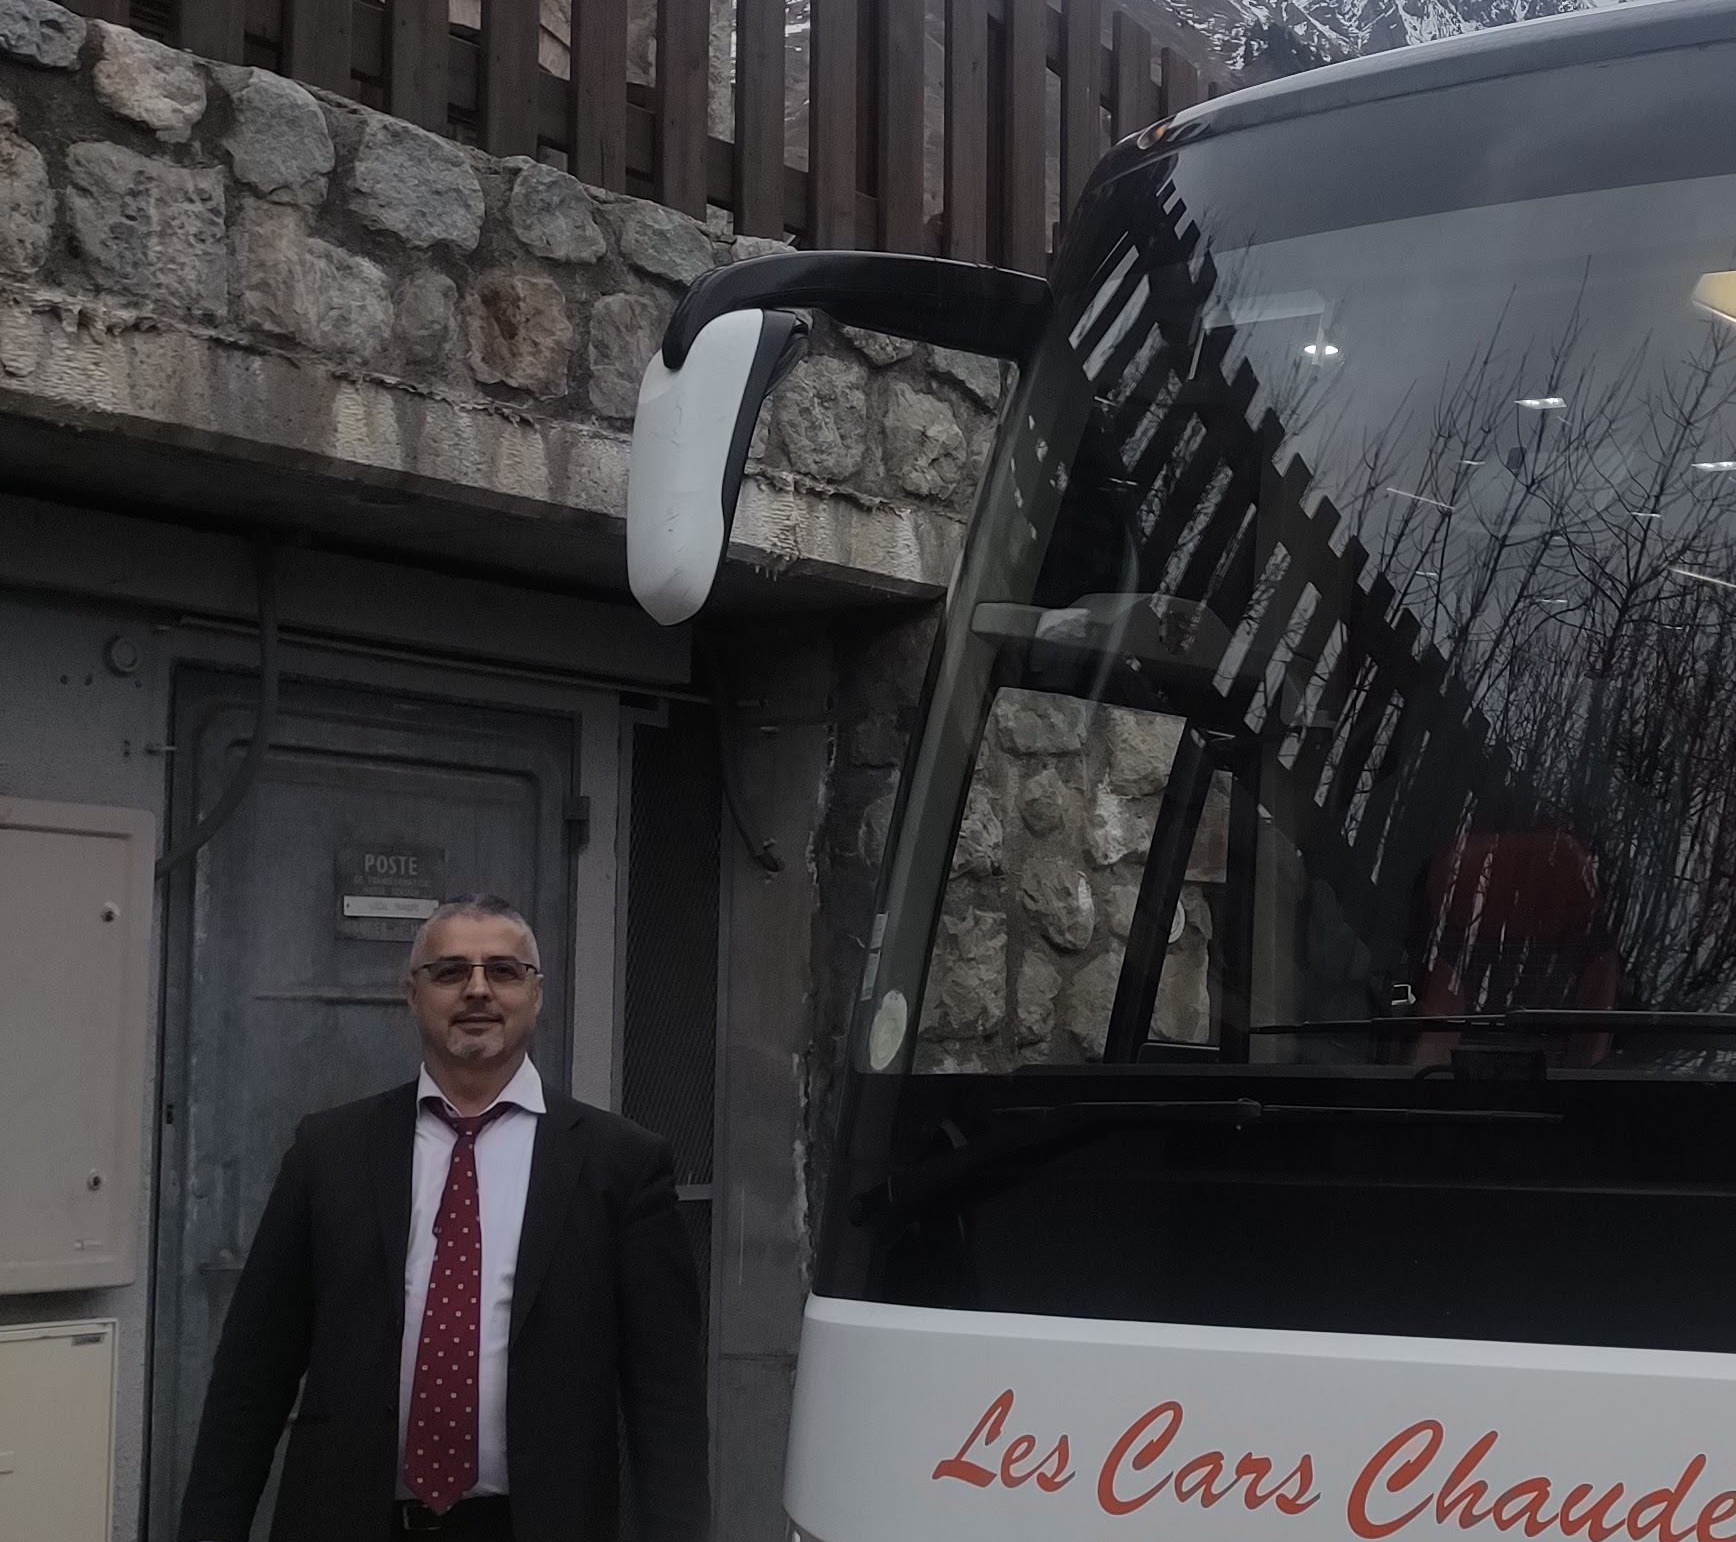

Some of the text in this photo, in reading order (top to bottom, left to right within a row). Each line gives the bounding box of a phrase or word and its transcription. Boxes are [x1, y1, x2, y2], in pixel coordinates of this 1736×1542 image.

[364, 854, 418, 876] POSTE
[932, 1390, 1074, 1493] Les
[1096, 1401, 1320, 1517] Cars
